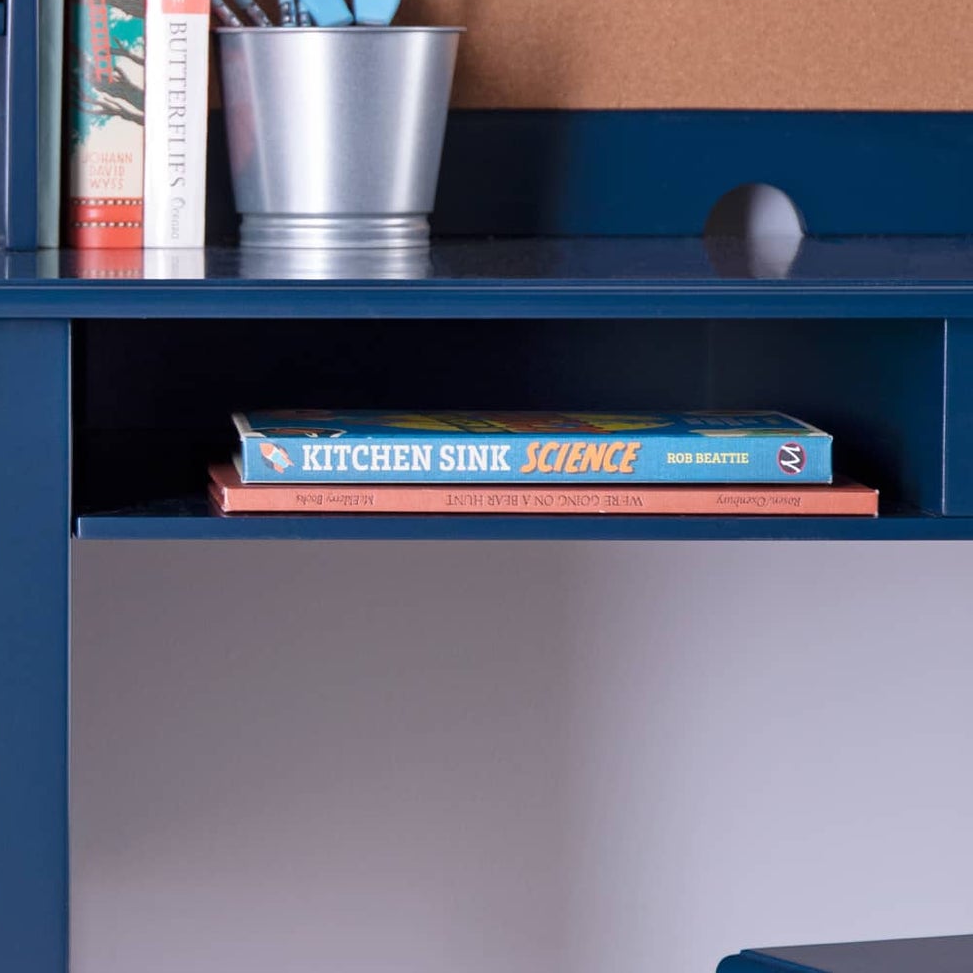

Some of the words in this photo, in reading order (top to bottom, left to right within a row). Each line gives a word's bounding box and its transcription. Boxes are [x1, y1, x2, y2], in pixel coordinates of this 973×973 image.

[168, 22, 187, 188] BUTTERFLIES
[90, 165, 125, 177] DAVID
[302, 444, 433, 471] KITCHEN
[439, 444, 511, 471] SINK
[519, 441, 642, 474] SCIENCE
[667, 452, 693, 464] ROB
[695, 452, 749, 464] BEATTIE
[445, 494, 484, 506] HUNT
[487, 494, 519, 506] BEAR
[522, 495, 533, 506] A
[534, 495, 555, 507] ON
[558, 495, 601, 507] GOING
